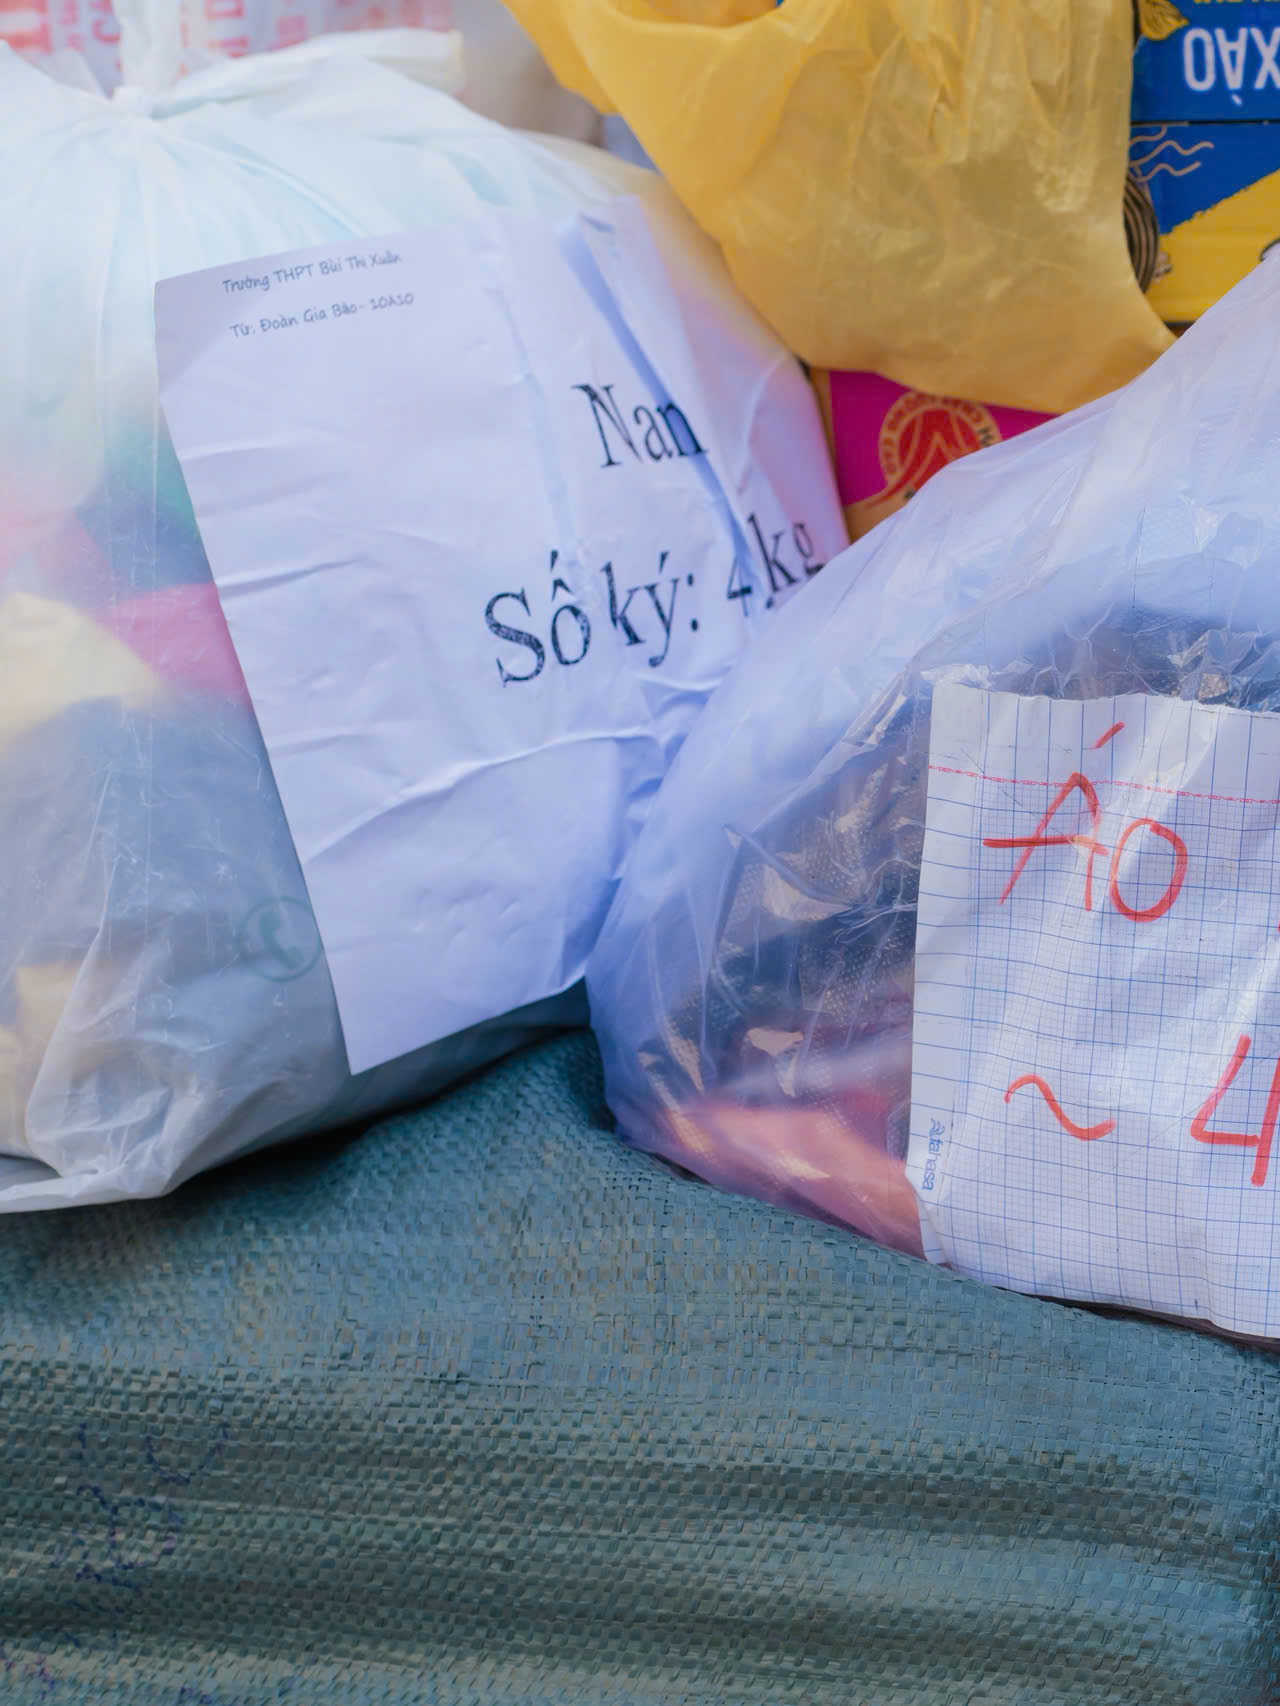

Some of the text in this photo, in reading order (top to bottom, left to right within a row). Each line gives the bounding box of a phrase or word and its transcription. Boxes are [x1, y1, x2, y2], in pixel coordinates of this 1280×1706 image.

[273, 263, 314, 283] THPT
[303, 306, 328, 323] Gia
[484, 549, 592, 688] Số
[600, 549, 700, 668] ký:
[982, 722, 1188, 923] Áo
